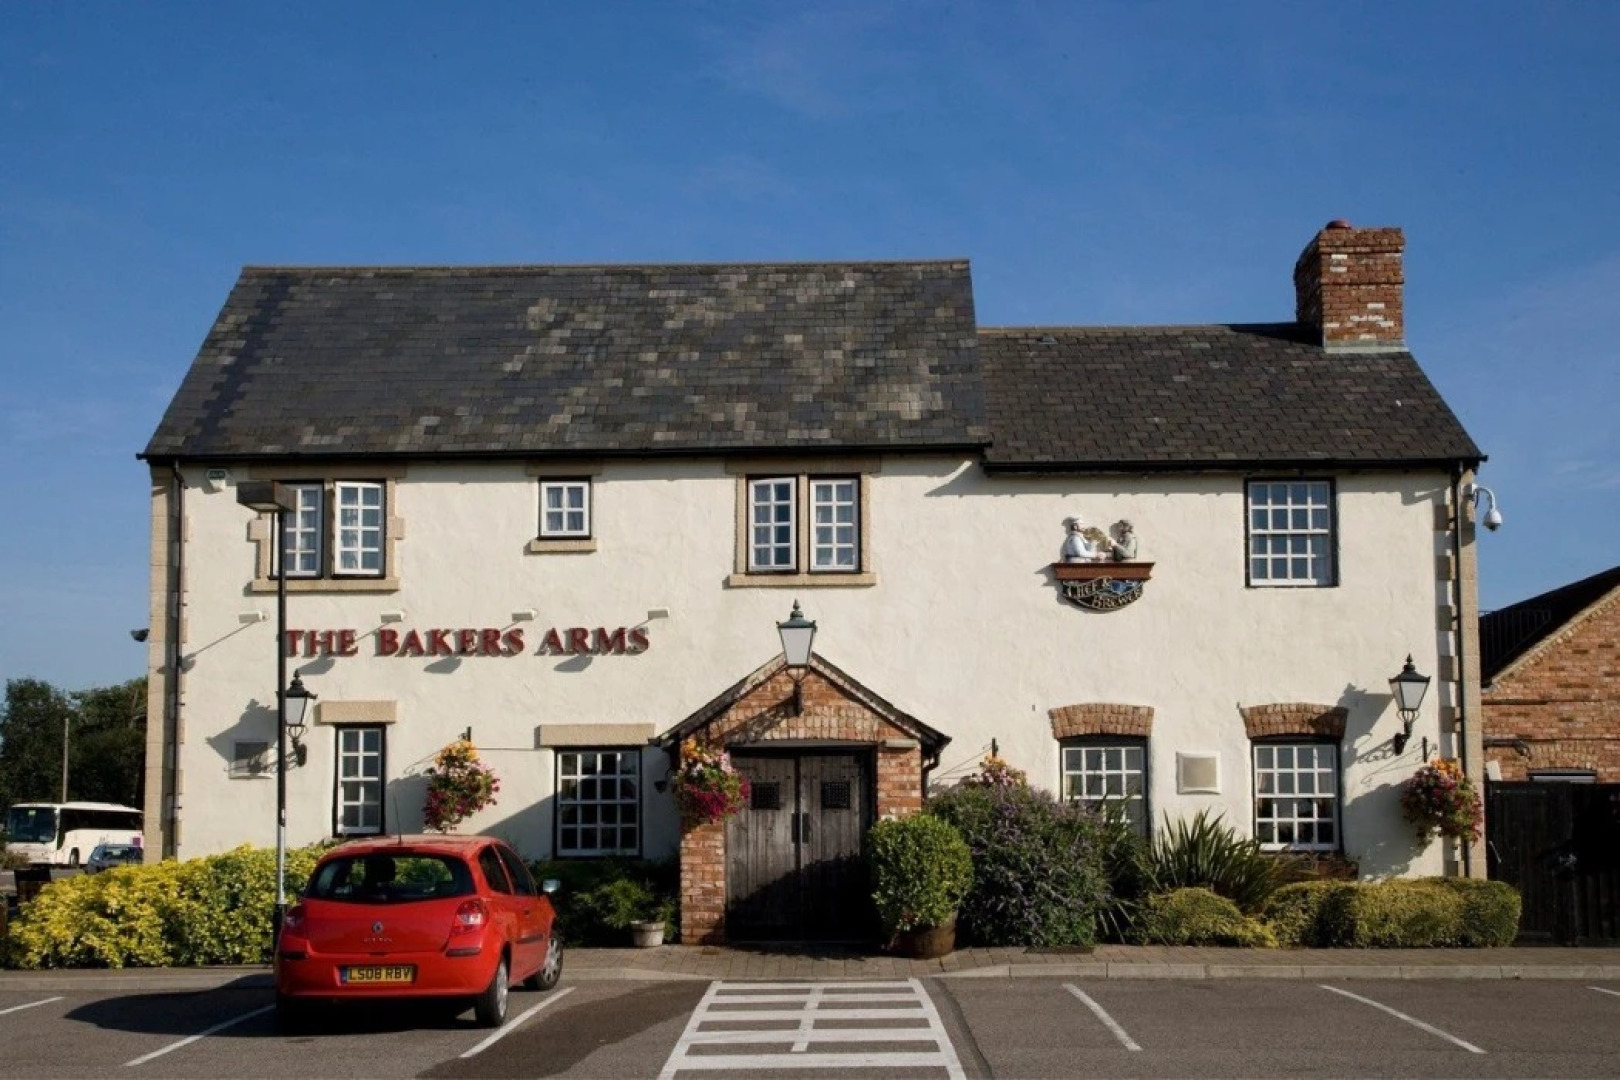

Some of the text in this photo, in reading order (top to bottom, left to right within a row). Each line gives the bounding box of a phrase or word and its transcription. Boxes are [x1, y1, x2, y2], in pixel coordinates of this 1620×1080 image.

[285, 627, 649, 656] THE BAKERS ARMS
[350, 967, 382, 980] LS08
